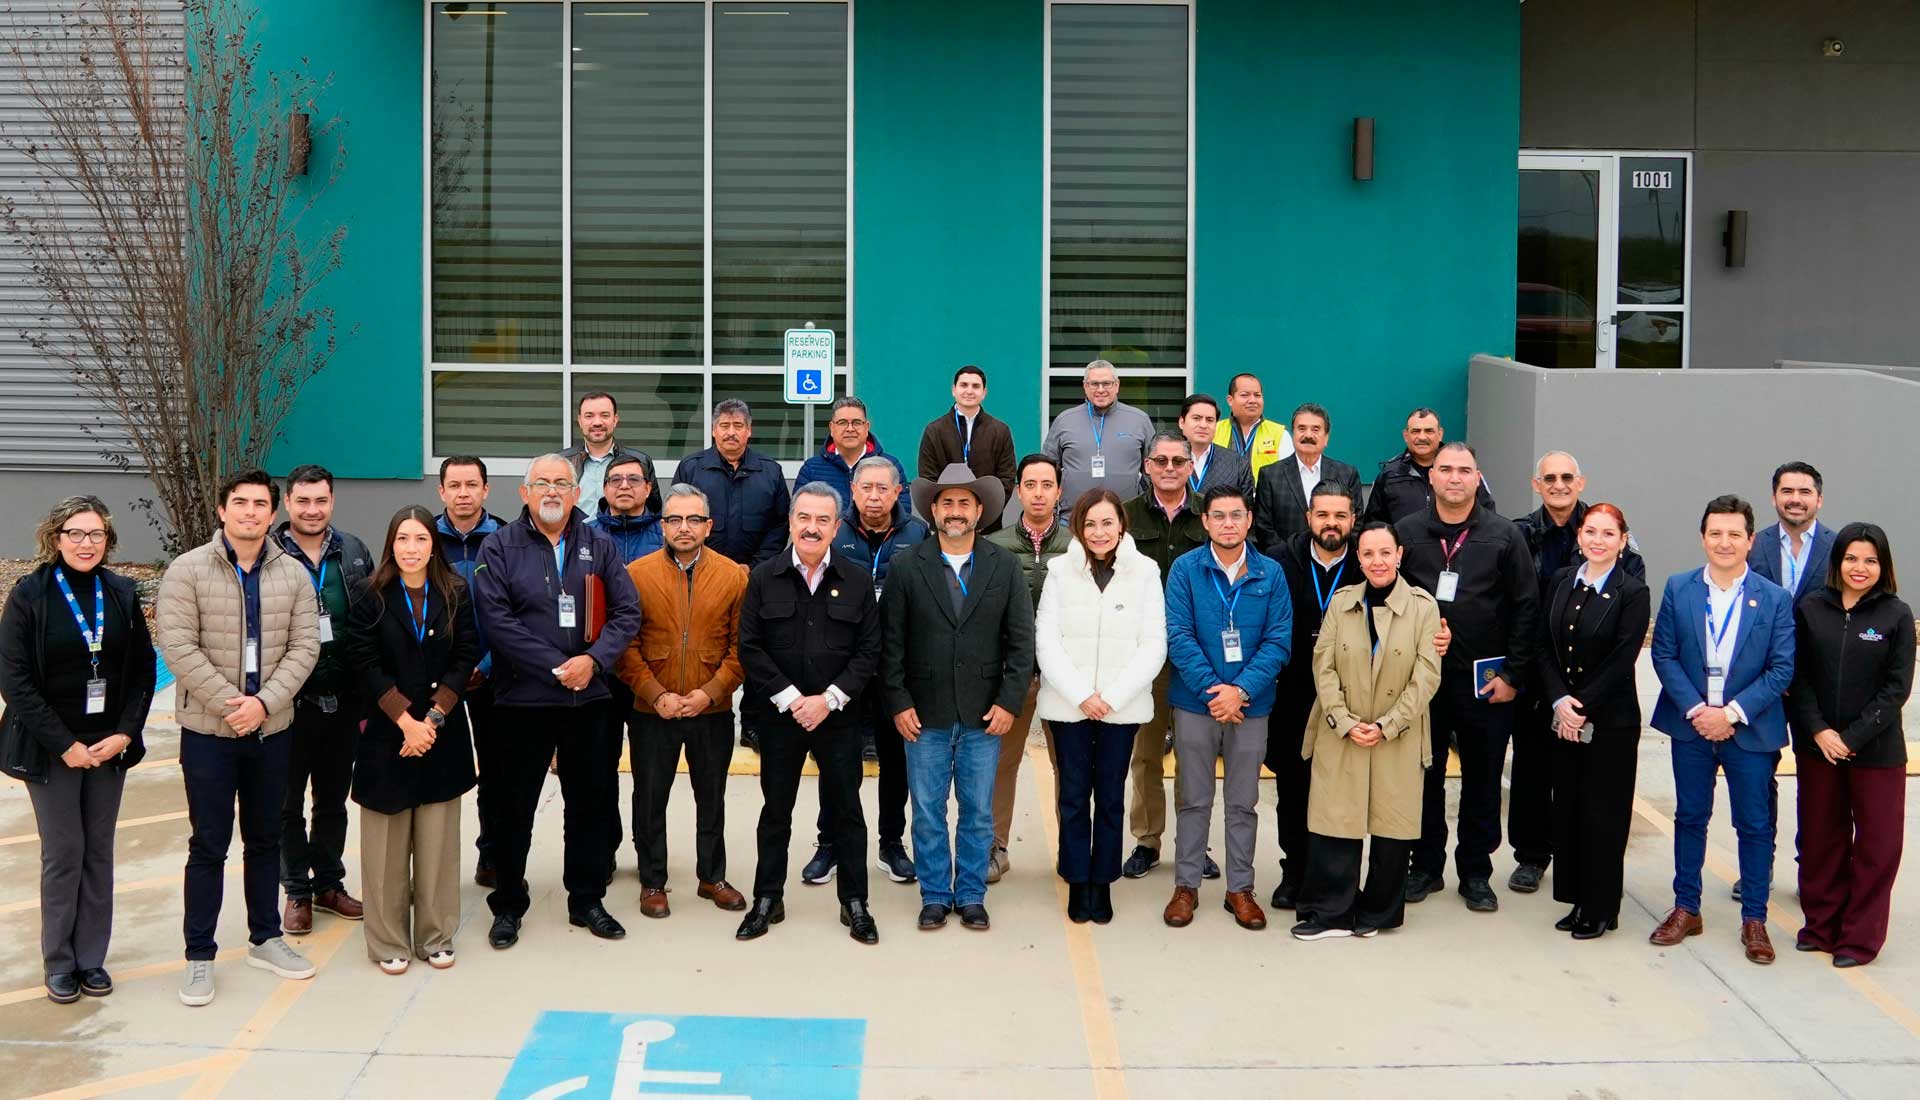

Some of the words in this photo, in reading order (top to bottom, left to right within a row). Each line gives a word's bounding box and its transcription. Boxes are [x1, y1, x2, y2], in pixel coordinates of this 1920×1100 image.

[1635, 172, 1669, 187] 1001
[789, 337, 830, 346] RESERVED
[791, 349, 827, 358] PARKING
